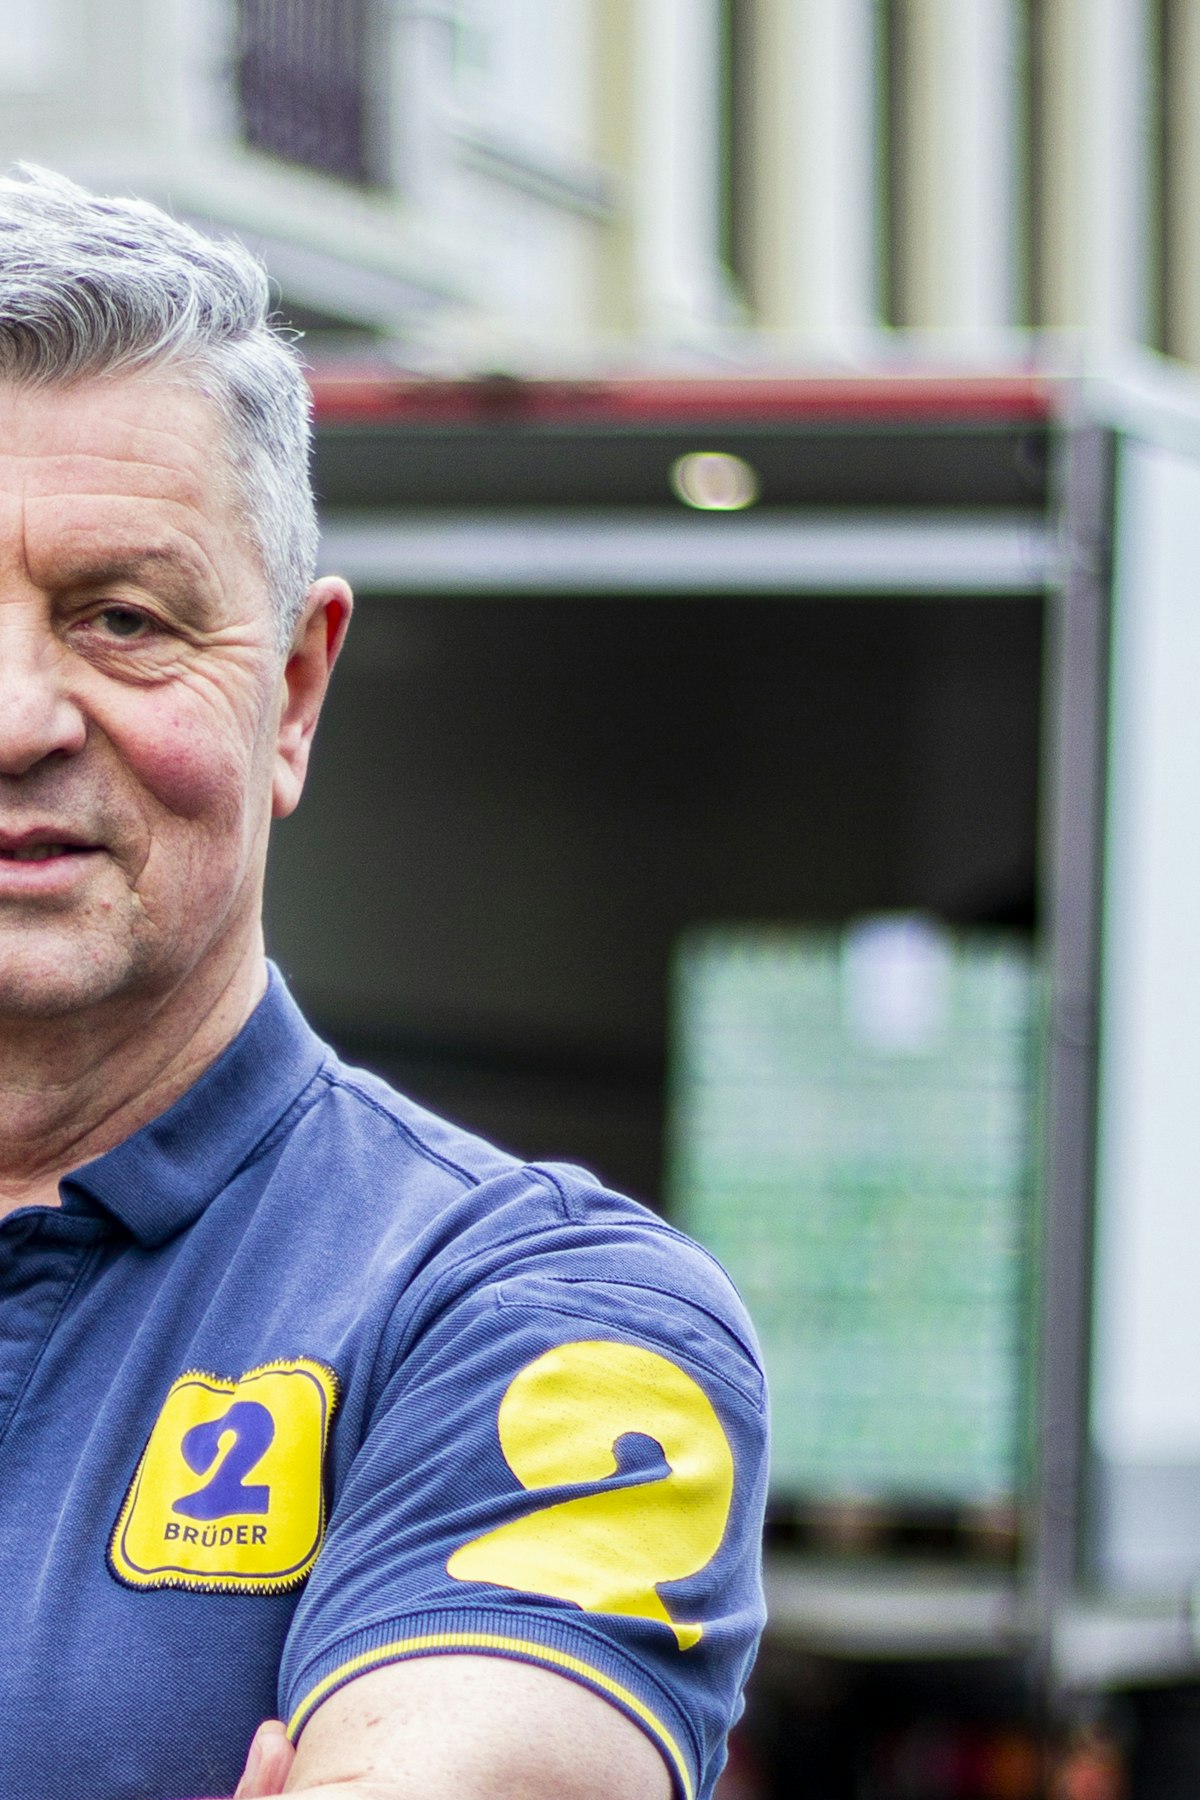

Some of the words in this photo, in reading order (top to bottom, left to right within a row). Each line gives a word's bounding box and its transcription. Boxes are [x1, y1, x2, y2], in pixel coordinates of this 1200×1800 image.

[172, 1401, 275, 1521] 2
[446, 1340, 734, 1651] 2
[164, 1522, 267, 1547] BRÜDER
